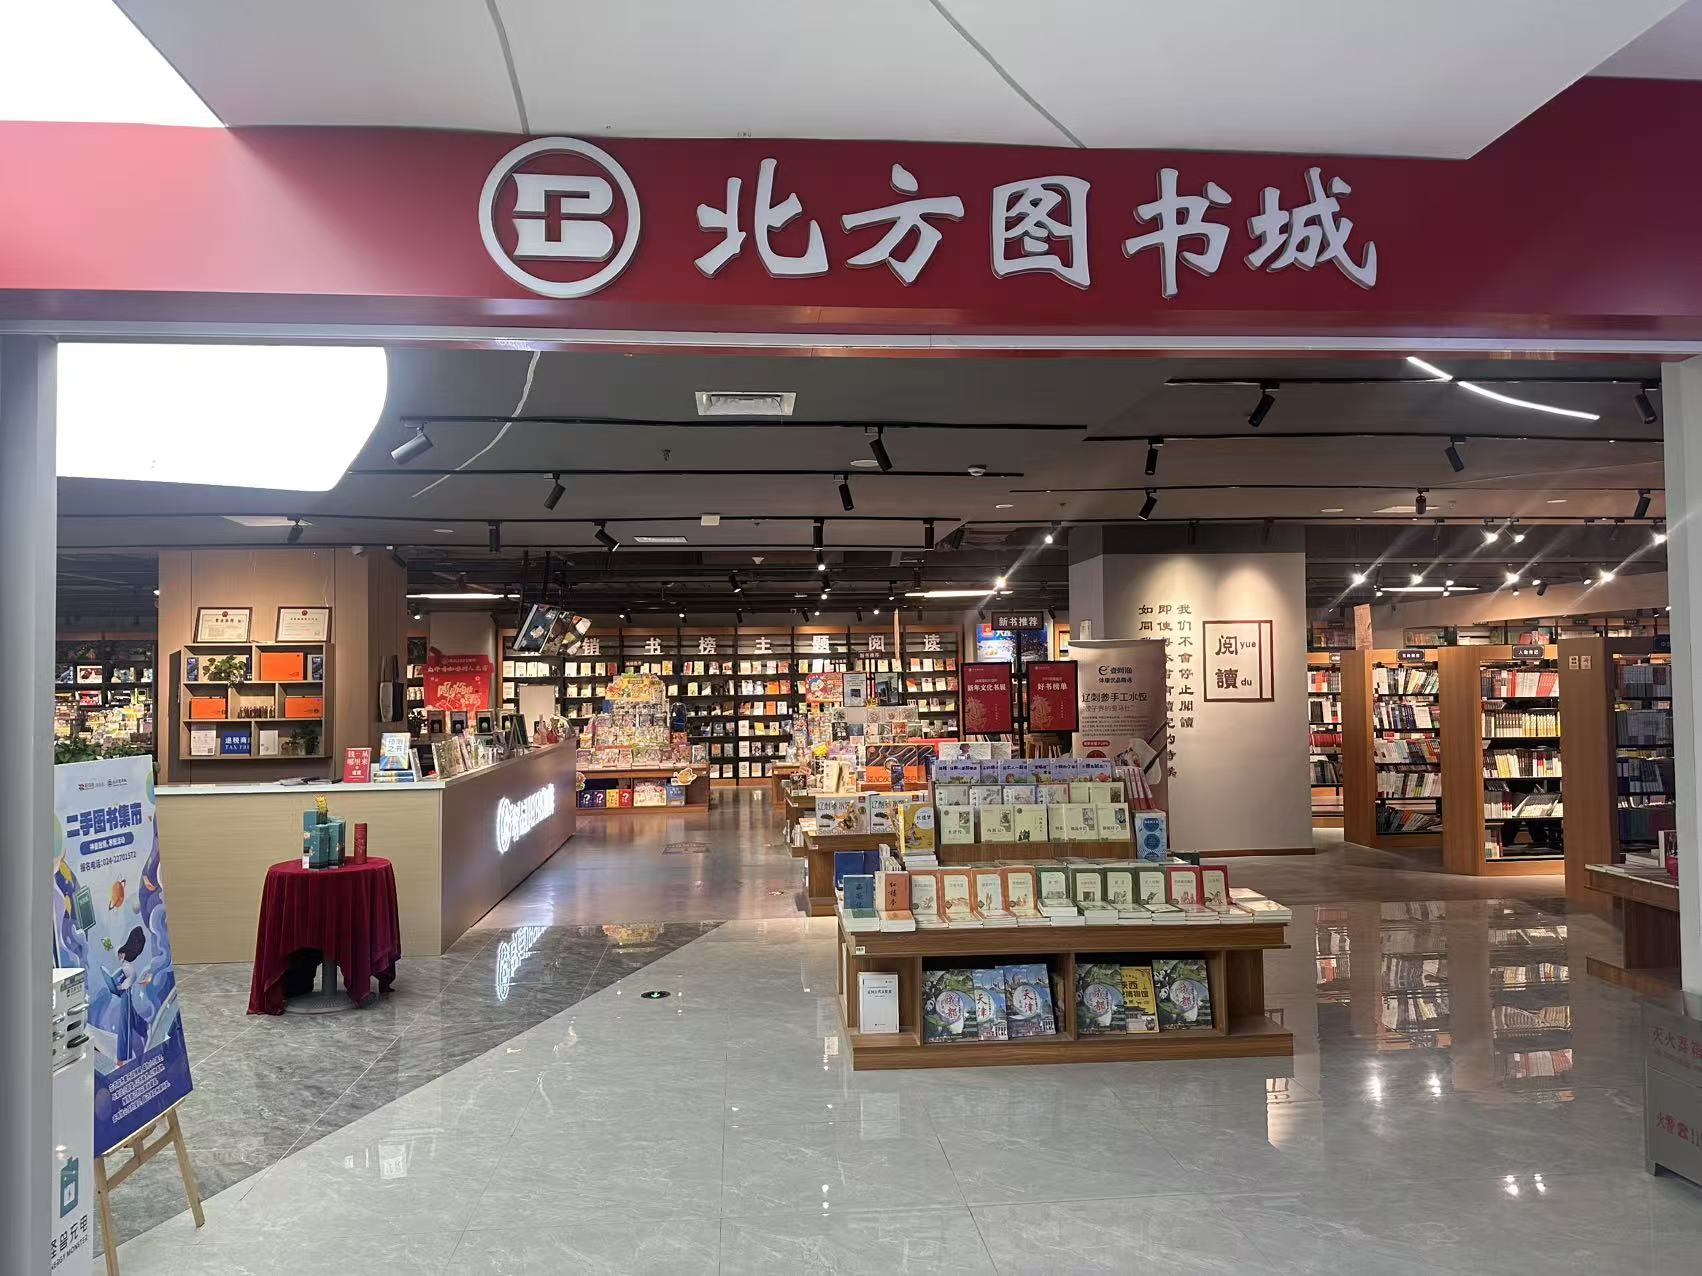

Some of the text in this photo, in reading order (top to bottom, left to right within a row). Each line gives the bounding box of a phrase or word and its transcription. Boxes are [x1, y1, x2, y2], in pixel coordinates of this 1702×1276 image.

[694, 157, 1377, 299] 北方图书城
[998, 616, 1038, 627] 新书推荐
[1240, 641, 1256, 649] yue
[1240, 677, 1252, 686] du
[225, 736, 250, 744] 退税商
[66, 802, 142, 838] 二手图书集市
[1123, 990, 1149, 998] 博物馆
[977, 993, 987, 1018] 天津
[1023, 988, 1034, 1013] 天津
